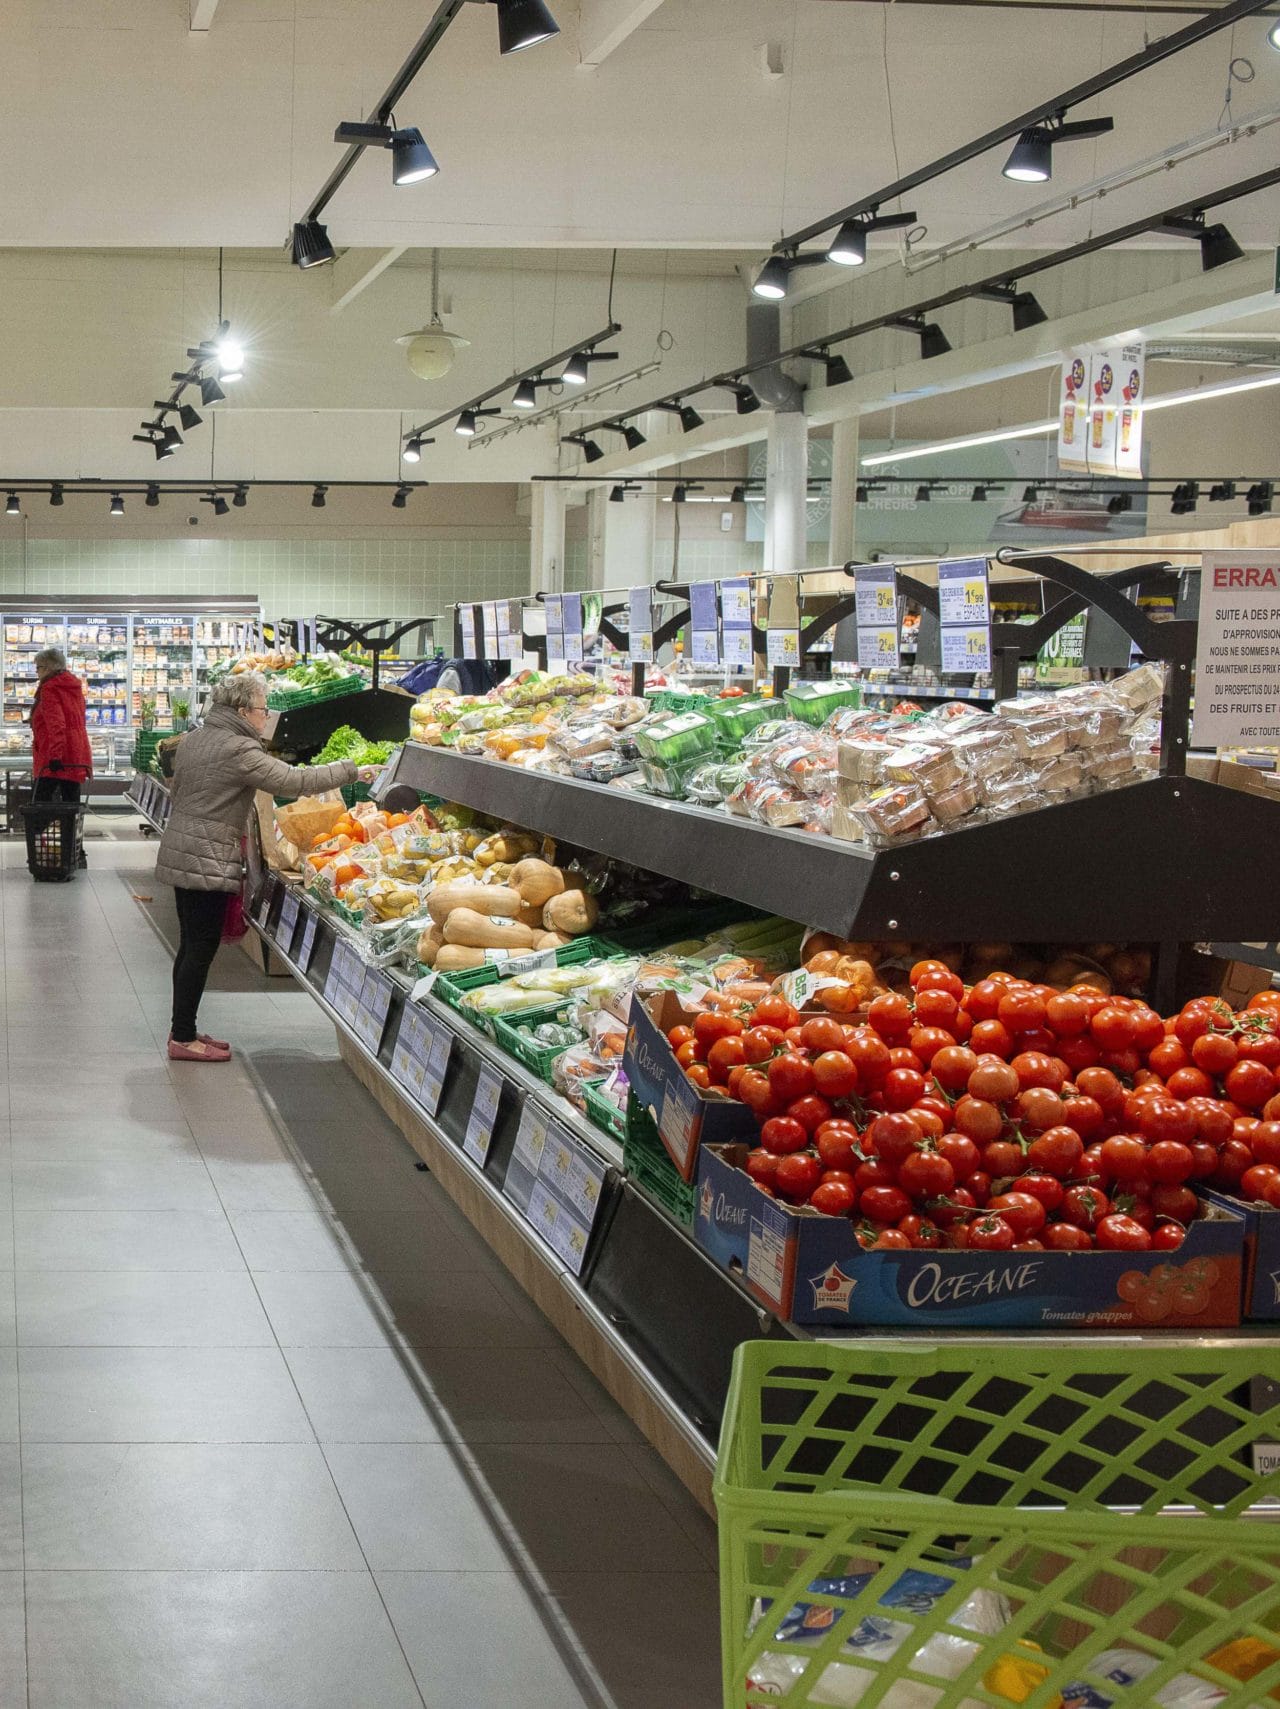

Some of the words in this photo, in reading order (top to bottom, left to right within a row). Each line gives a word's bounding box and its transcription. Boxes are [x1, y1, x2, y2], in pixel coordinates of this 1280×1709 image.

[877, 592, 894, 607] 3€49
[965, 589, 984, 604] 1€99
[143, 617, 183, 625] TARTINABLES
[1215, 609, 1240, 621] SUITE
[1242, 609, 1249, 621] A
[1251, 609, 1268, 621] DES
[967, 638, 987, 654] 1€49
[1209, 646, 1229, 656] NOUS
[1230, 646, 1240, 656] NE
[1240, 646, 1269, 656] SOMMES
[1270, 646, 1280, 656] PA
[1205, 664, 1214, 674] DE
[1215, 664, 1249, 674] MAINTENIR
[1249, 664, 1262, 674] LES
[1262, 664, 1276, 674] PRIX
[1215, 685, 1224, 695] DU
[1224, 685, 1263, 695] PROSPECTUS
[1264, 685, 1272, 695] DU
[1210, 703, 1228, 713] DES
[1231, 703, 1263, 713] FRUITS
[1265, 703, 1277, 713] ET
[1240, 727, 1258, 736] AVEC
[638, 1042, 666, 1082] OCEANE
[715, 1192, 749, 1226] OCEANE
[908, 1261, 1044, 1307] OCEANE
[1041, 1308, 1086, 1320] Tomates
[1086, 1310, 1133, 1323] grappes
